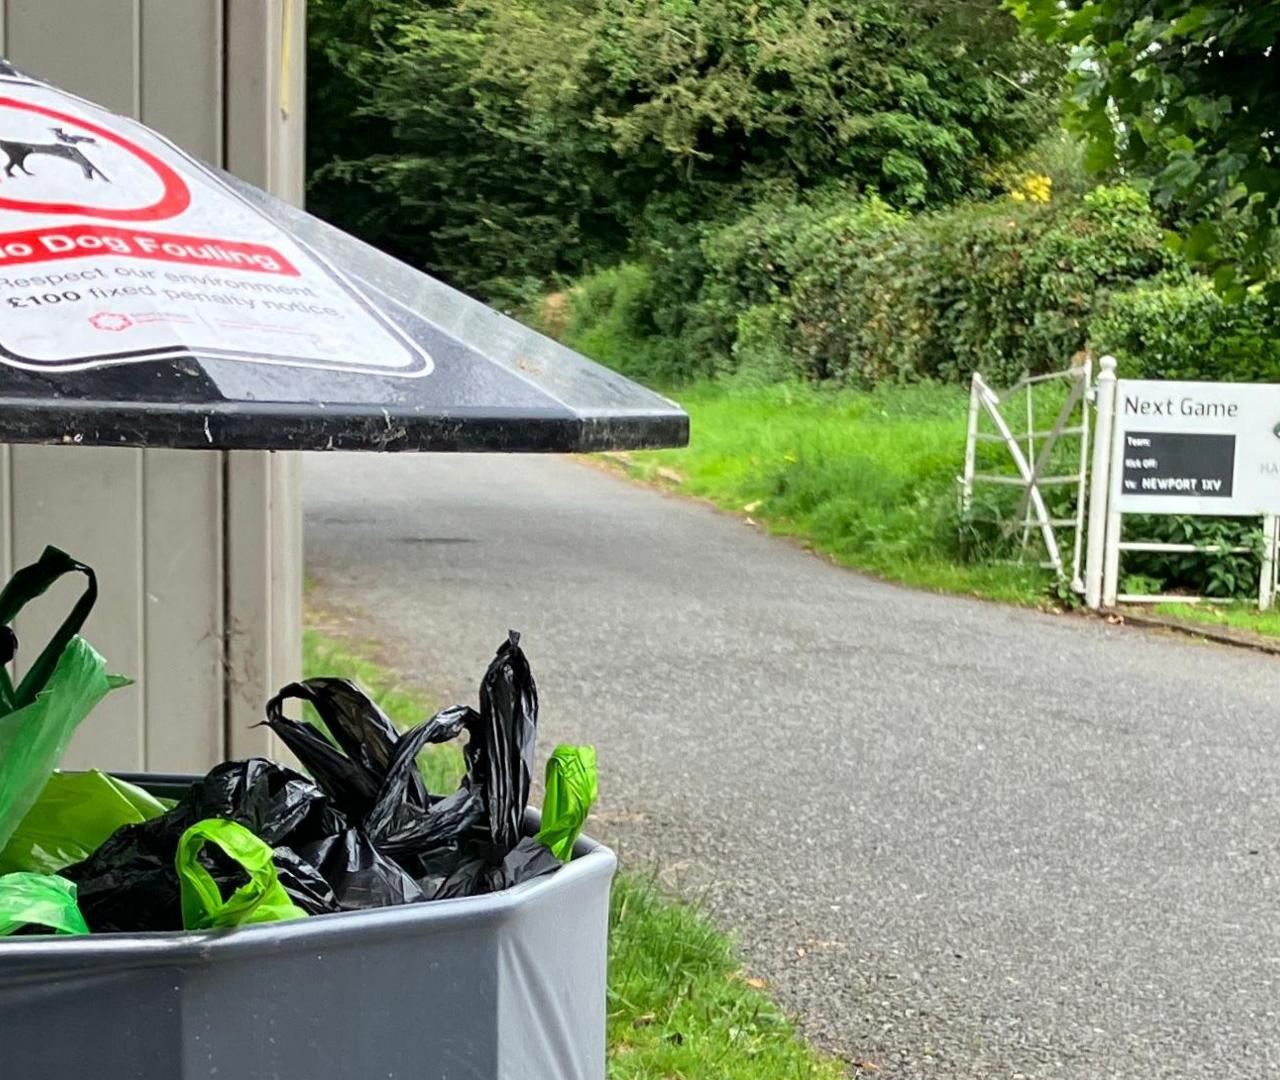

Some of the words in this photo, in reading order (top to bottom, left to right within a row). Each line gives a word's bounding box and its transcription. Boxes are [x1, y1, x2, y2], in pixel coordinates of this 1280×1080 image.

[39, 234, 132, 254] Dog
[134, 236, 281, 272] Fouling
[115, 267, 155, 279] our
[164, 271, 318, 298] environment
[6, 291, 81, 308] £100
[89, 285, 155, 300] fixed
[163, 286, 255, 310] penalty
[264, 300, 346, 318] notice.
[1124, 396, 1174, 416] Next
[1180, 397, 1239, 417] Game
[1141, 477, 1197, 491] NEWPORT
